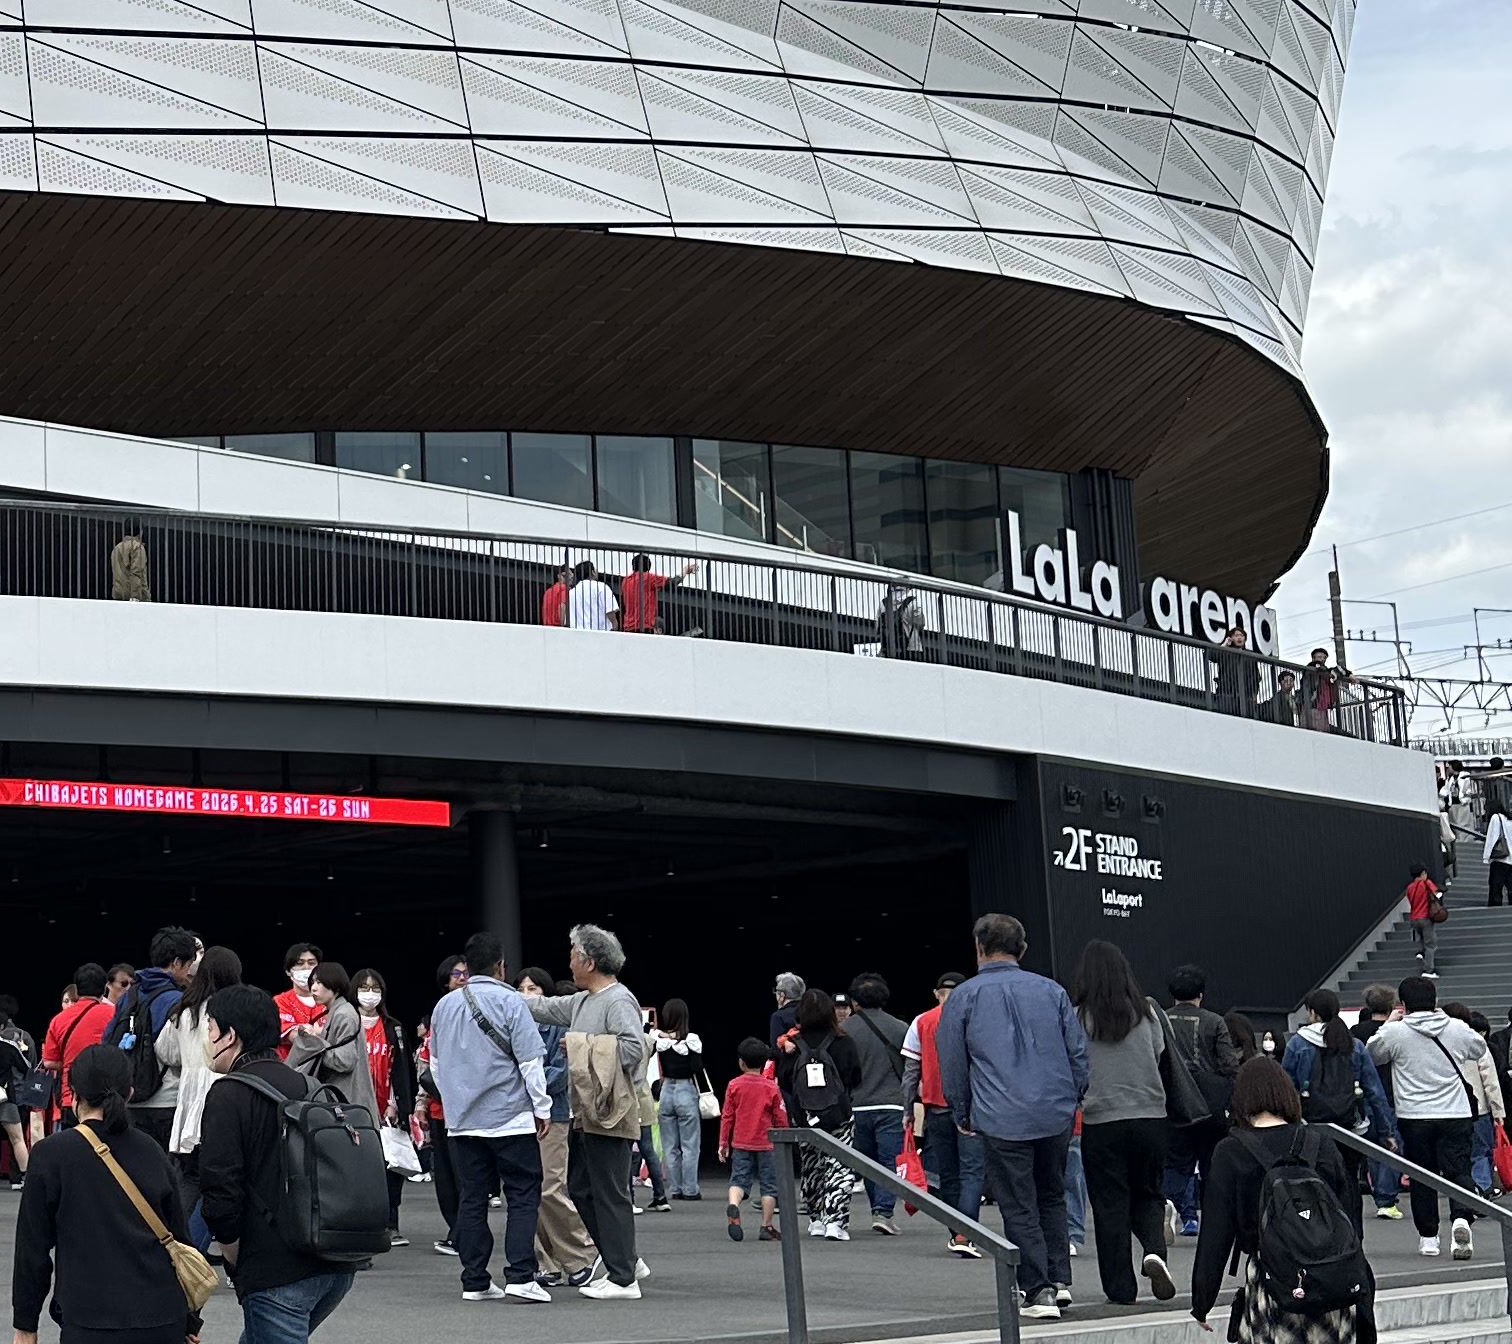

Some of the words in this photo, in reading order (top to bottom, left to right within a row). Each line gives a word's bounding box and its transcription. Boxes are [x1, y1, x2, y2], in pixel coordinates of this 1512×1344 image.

[1007, 509, 1123, 620] LaLa
[1150, 575, 1279, 658] arena
[24, 782, 108, 806] CHIBAJETS
[114, 787, 195, 810] HOMEGAME
[201, 792, 278, 814] 2026.4.25
[342, 799, 371, 819] SUN
[1062, 826, 1093, 871] 2F
[1095, 833, 1139, 857] STAND
[1096, 853, 1163, 880] ENTRANCE
[1101, 887, 1143, 909] LaLaport
